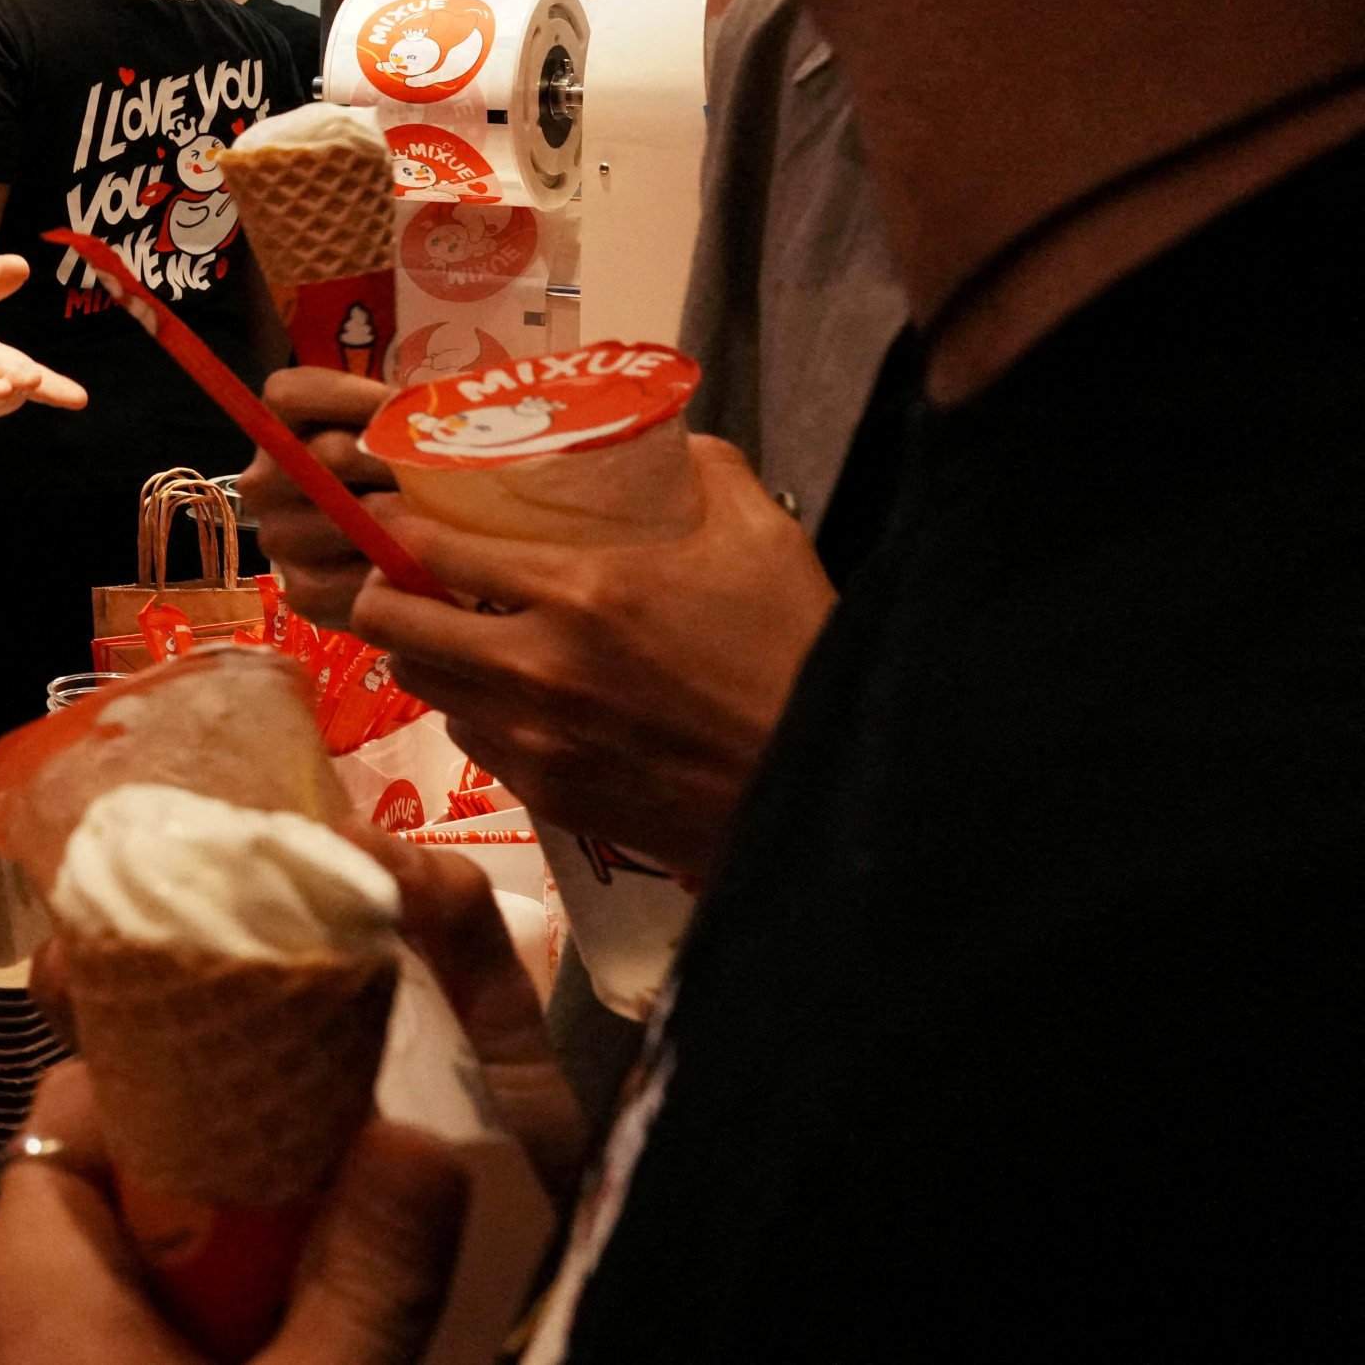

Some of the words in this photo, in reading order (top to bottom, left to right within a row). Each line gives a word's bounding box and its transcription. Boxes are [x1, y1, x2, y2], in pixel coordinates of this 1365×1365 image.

[73, 82, 102, 173] I
[98, 74, 189, 162] LOVE
[193, 58, 263, 135] YOU
[408, 142, 476, 182] MIXUE
[56, 163, 164, 287] YOU
[166, 252, 216, 301] ME
[457, 349, 675, 402] MIXUE
[380, 797, 419, 830] MIXUE
[425, 832, 470, 844] LOVE
[476, 831, 512, 843] YOU
